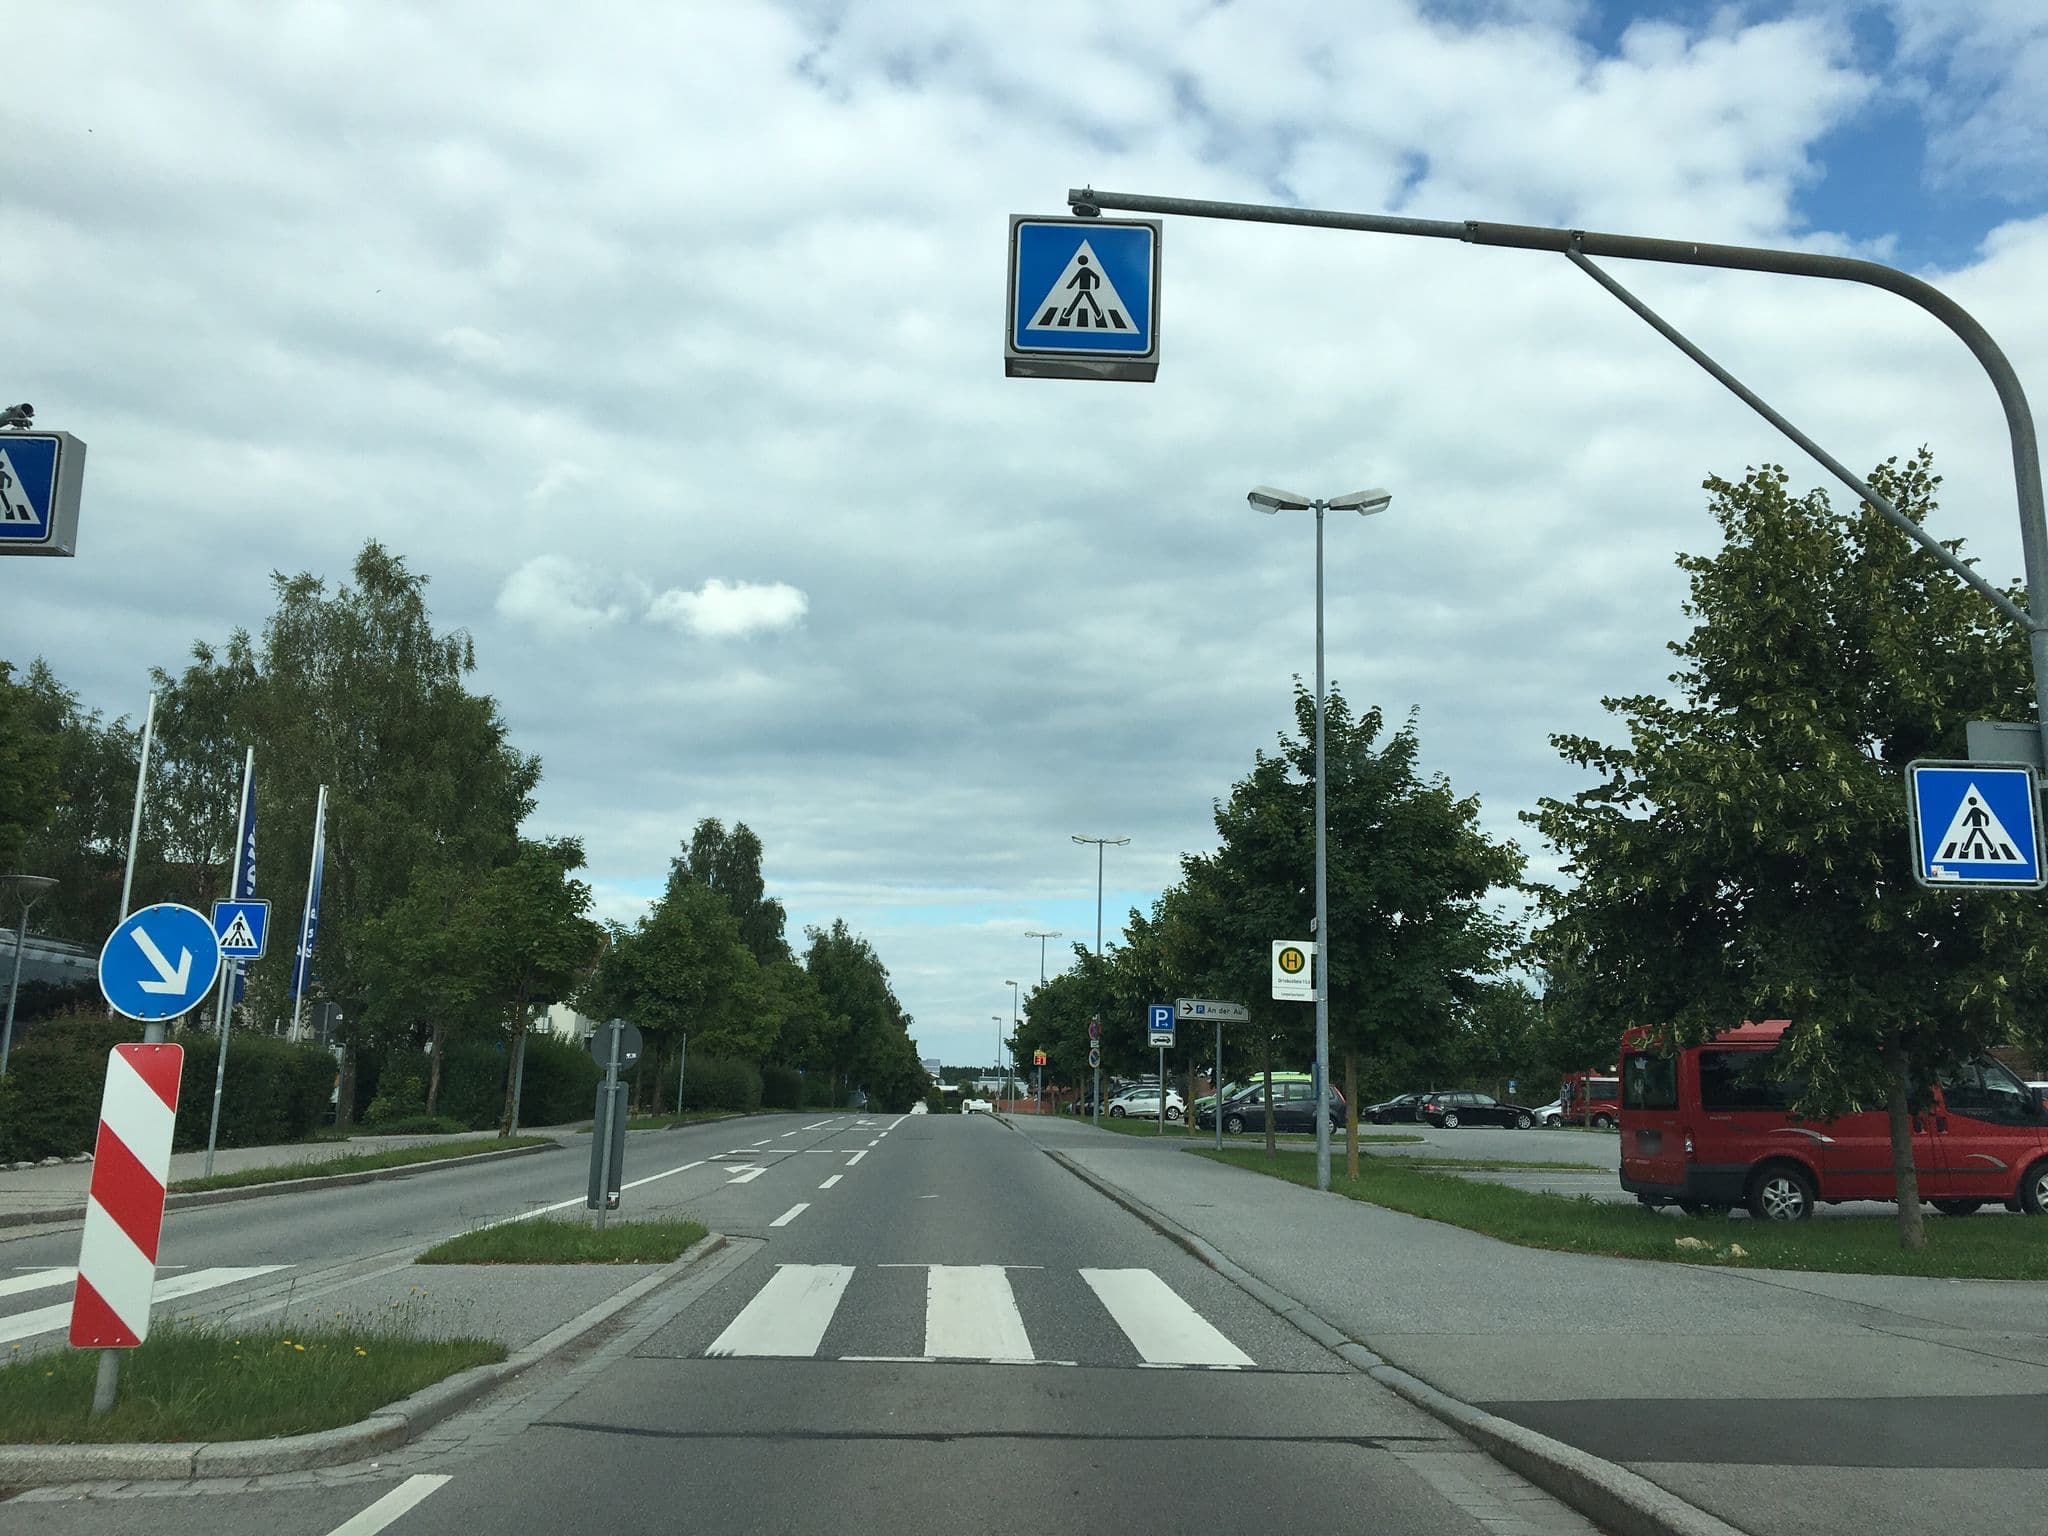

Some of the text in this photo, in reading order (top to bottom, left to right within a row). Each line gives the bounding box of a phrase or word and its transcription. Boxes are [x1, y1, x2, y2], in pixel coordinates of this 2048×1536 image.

[1286, 953, 1298, 968] H
[1207, 1006, 1217, 1014] An
[1219, 1007, 1230, 1015] der
[1155, 1009, 1169, 1028] P
